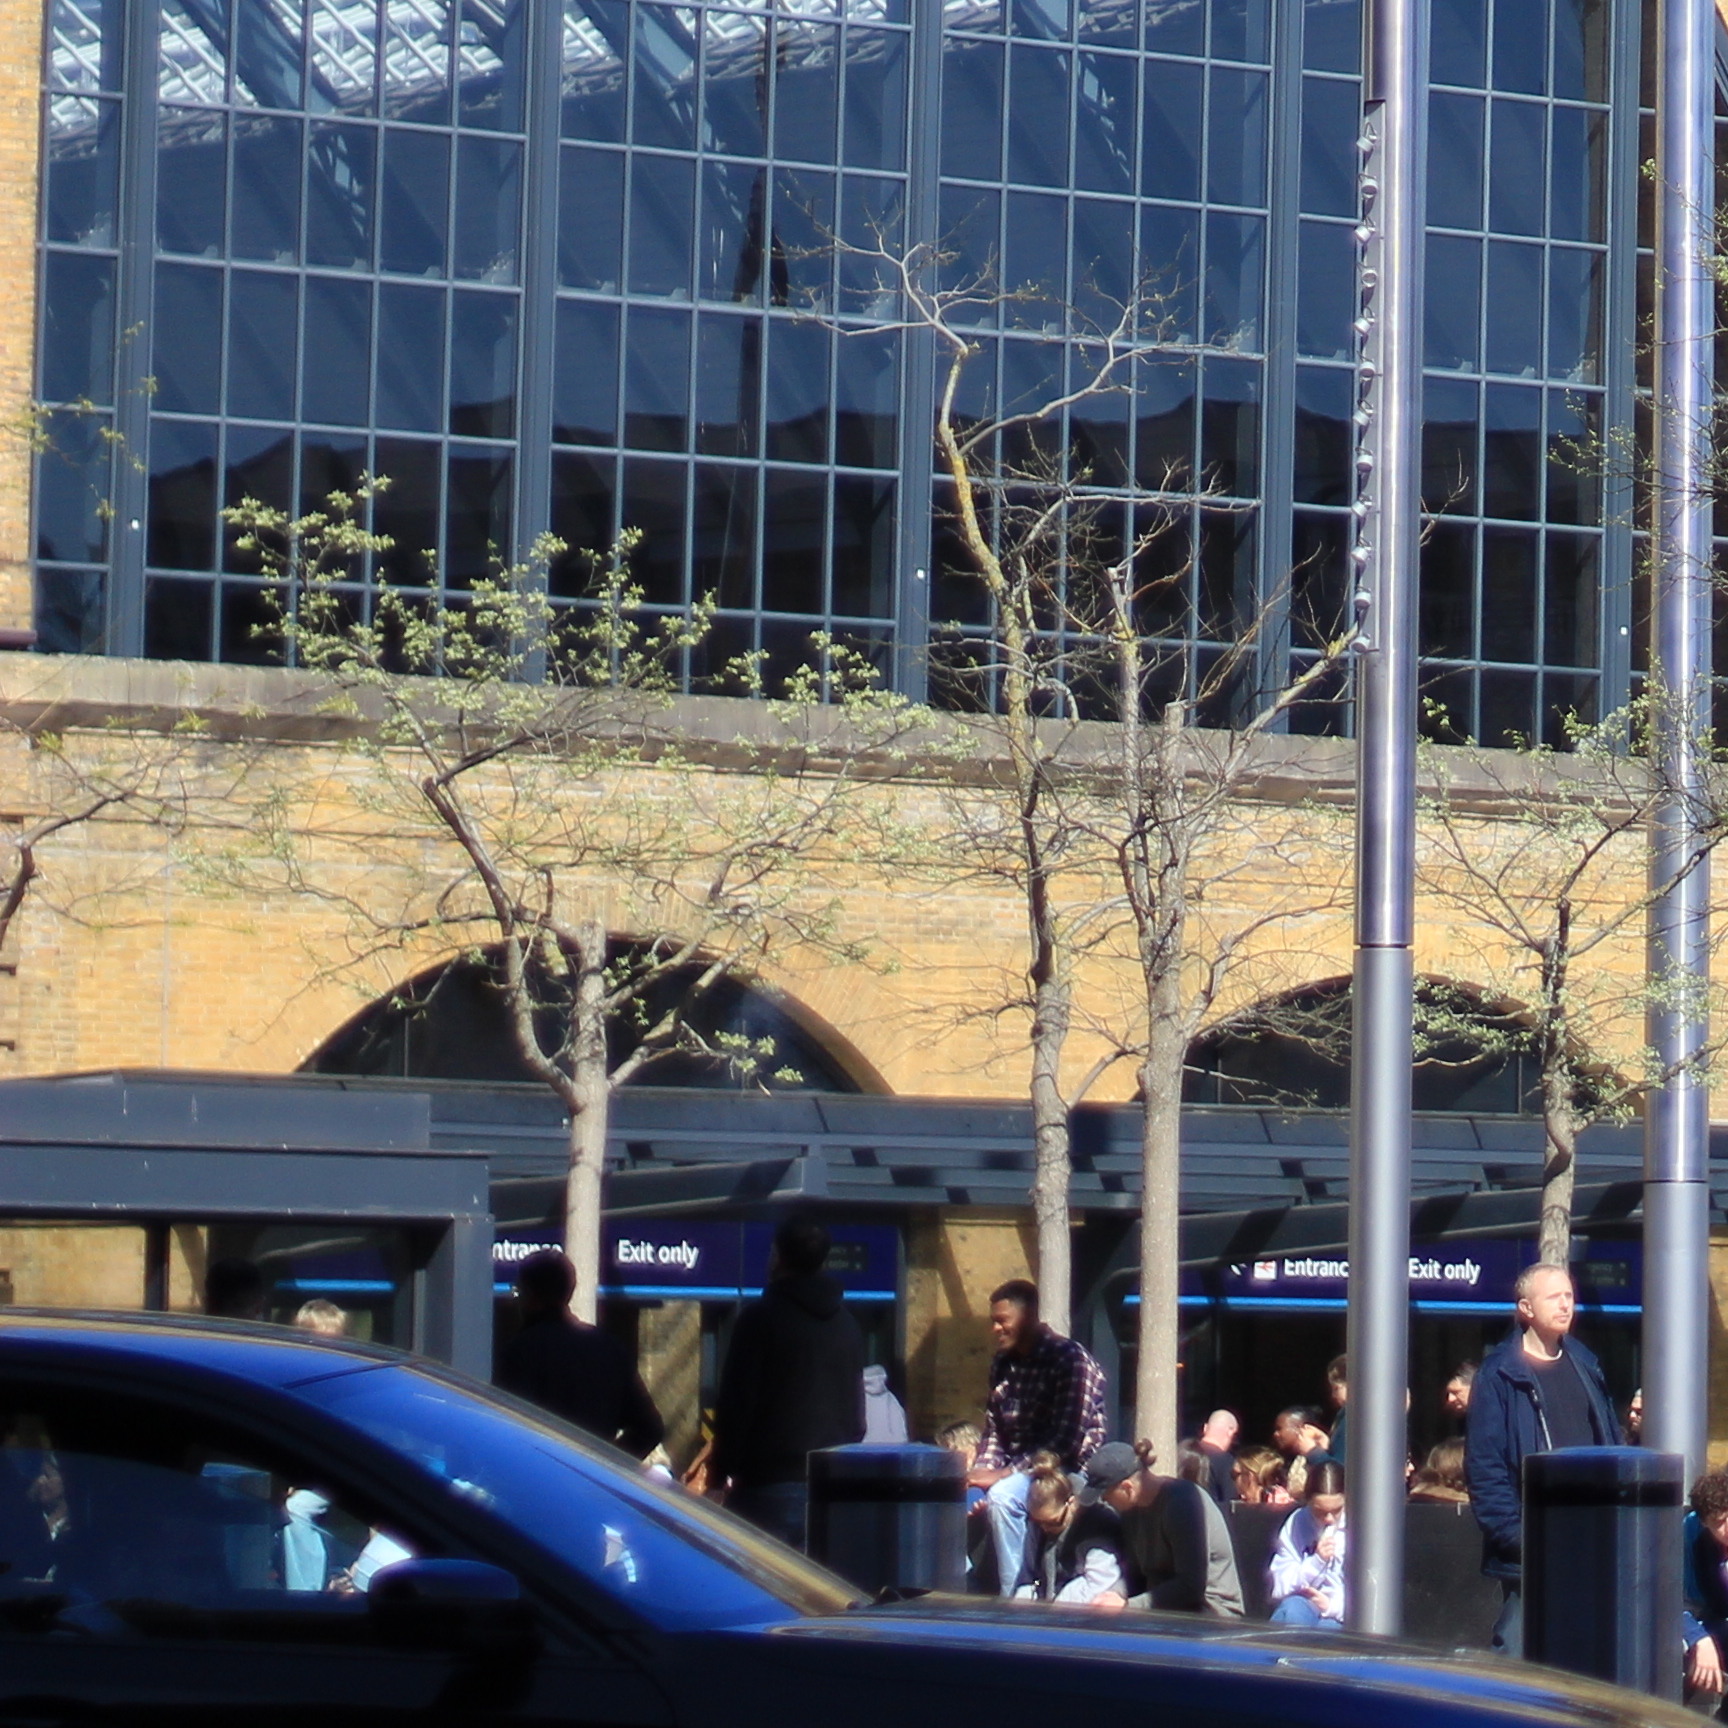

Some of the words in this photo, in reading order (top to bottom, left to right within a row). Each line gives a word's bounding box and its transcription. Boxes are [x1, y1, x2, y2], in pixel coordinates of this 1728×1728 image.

[617, 1238, 655, 1264] Exit
[657, 1238, 699, 1269] only
[1284, 1257, 1349, 1278] Entranc
[1409, 1258, 1441, 1280] Exit
[1444, 1258, 1481, 1285] only
